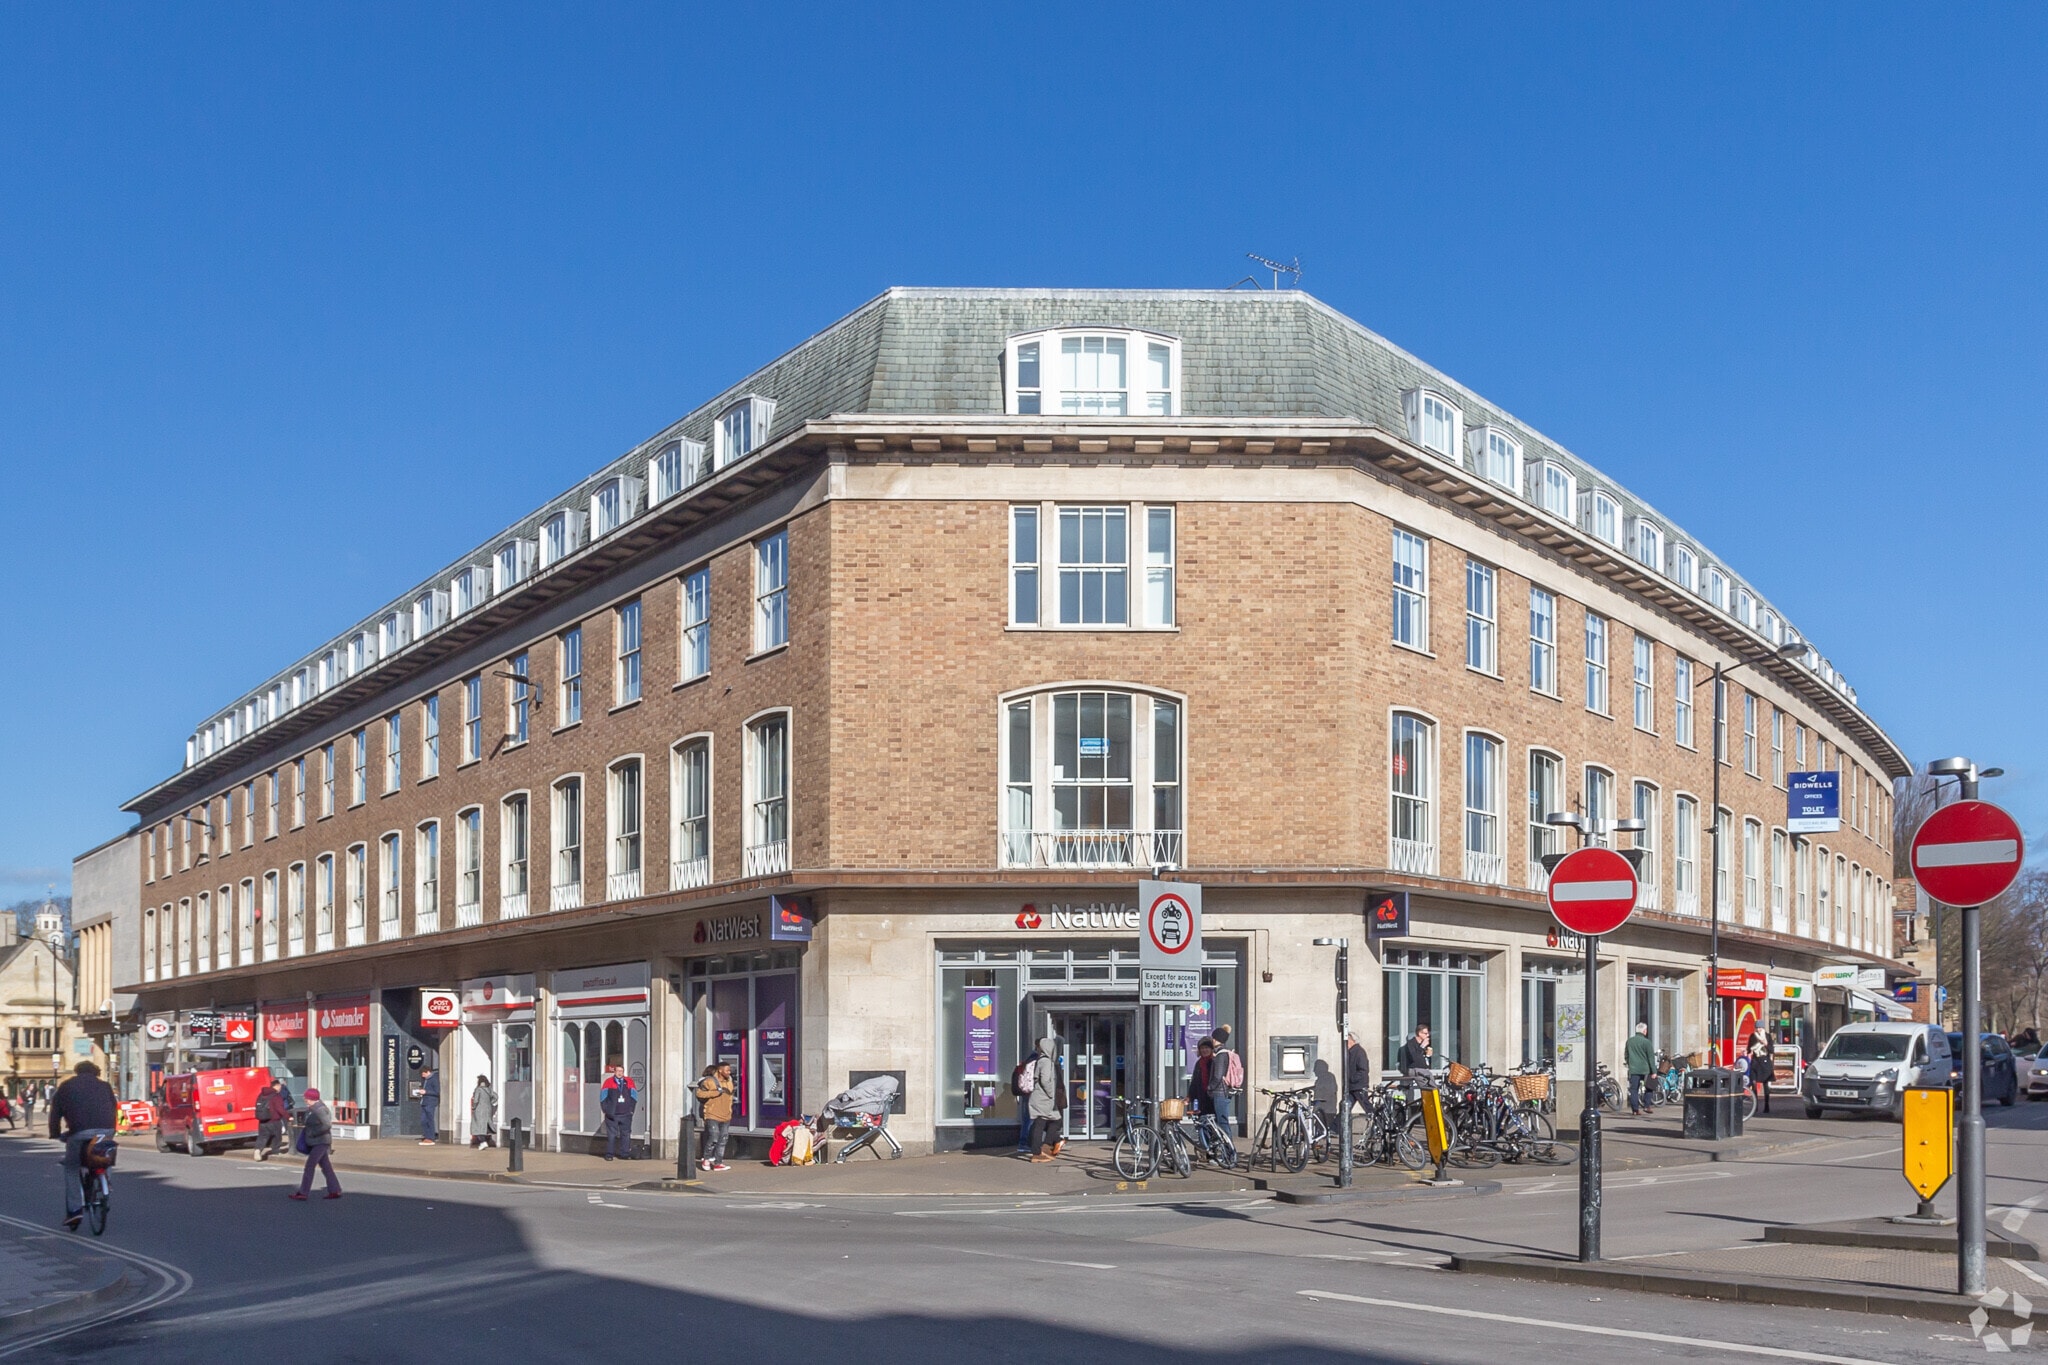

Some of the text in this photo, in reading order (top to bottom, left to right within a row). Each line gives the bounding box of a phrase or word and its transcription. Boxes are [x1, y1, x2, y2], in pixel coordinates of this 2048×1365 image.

[1051, 903, 1139, 929] NatWe
[708, 915, 760, 942] NatWest
[1820, 972, 1854, 980] SUBWAY
[275, 1012, 304, 1030] Santander
[330, 1007, 365, 1027] Santander
[388, 1039, 395, 1047] ST
[767, 1031, 784, 1039] NatWest
